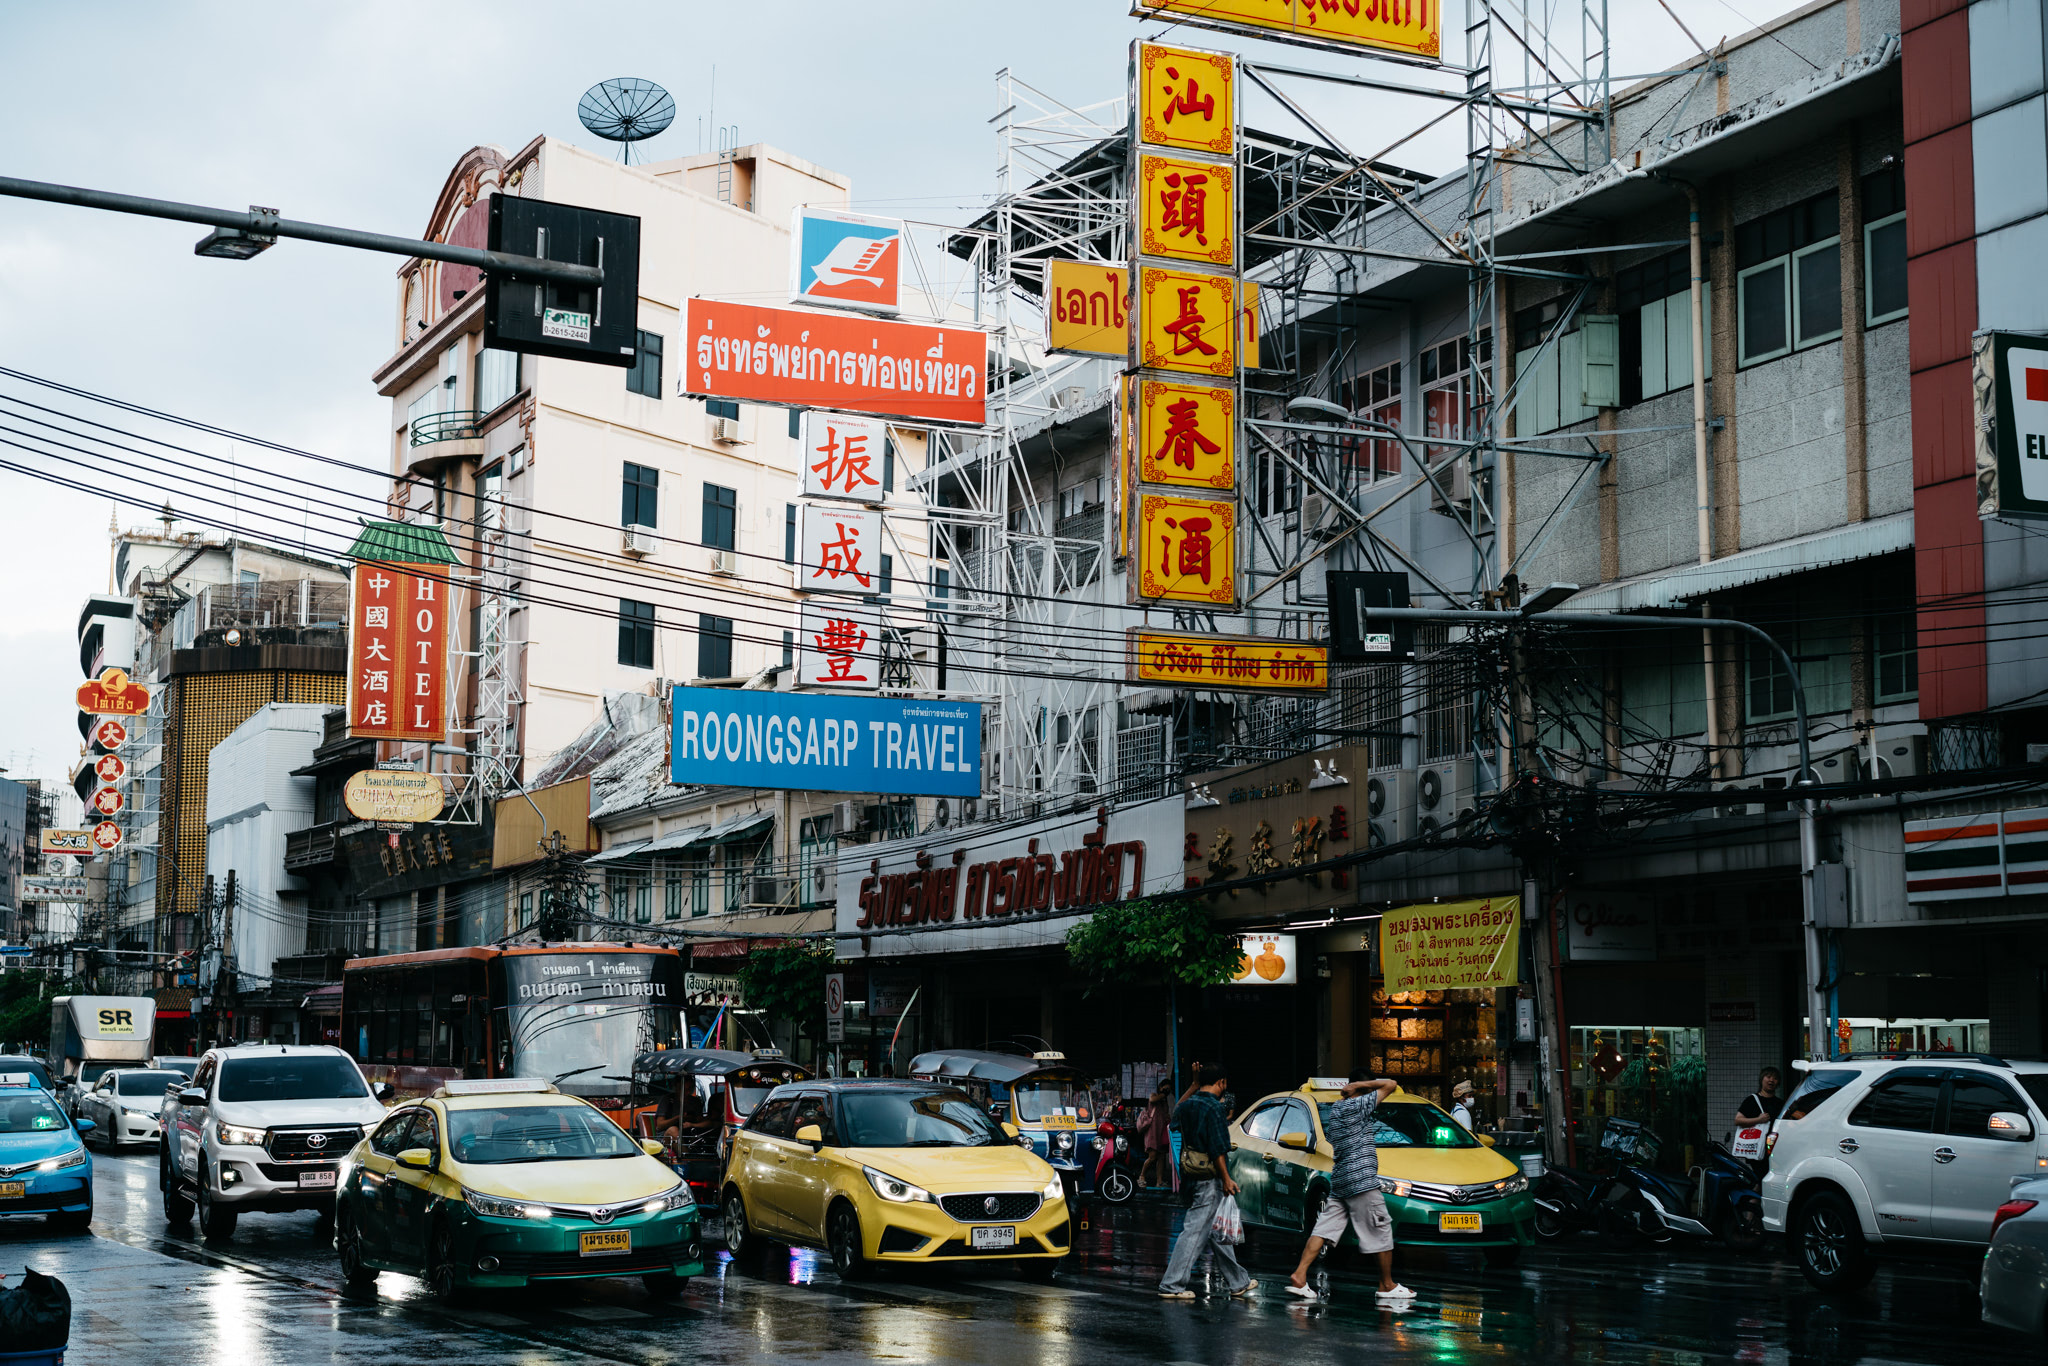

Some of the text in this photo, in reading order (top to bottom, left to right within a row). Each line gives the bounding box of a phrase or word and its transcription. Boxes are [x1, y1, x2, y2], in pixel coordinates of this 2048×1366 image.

[544, 310, 588, 328] FORTH
[1155, 67, 1221, 585] 汕頭長春酒
[544, 325, 588, 340] 0-2615-2440
[697, 319, 976, 398] รุ่งทรัพย์การท่องเที่ยว
[811, 426, 879, 683] 振成豐
[362, 572, 391, 725] 中國大酒店
[414, 575, 436, 728] HOTEL
[902, 705, 969, 720] รุ่งทรัพย์การท่องเที่ยว
[682, 710, 971, 773] ROONGSARP TRAVEL
[351, 787, 396, 802] CHINA
[1574, 902, 1648, 936] Glico
[1418, 940, 1425, 950] 4
[1429, 935, 1474, 949] สิงหาคม
[1479, 934, 1507, 946] 2565
[542, 964, 580, 976] ถนนตก
[586, 959, 595, 977] 1
[519, 980, 583, 998] ถนนตก
[99, 1009, 133, 1025] SR
[604, 1233, 627, 1245] 5680
[992, 1228, 1013, 1238] 3945
